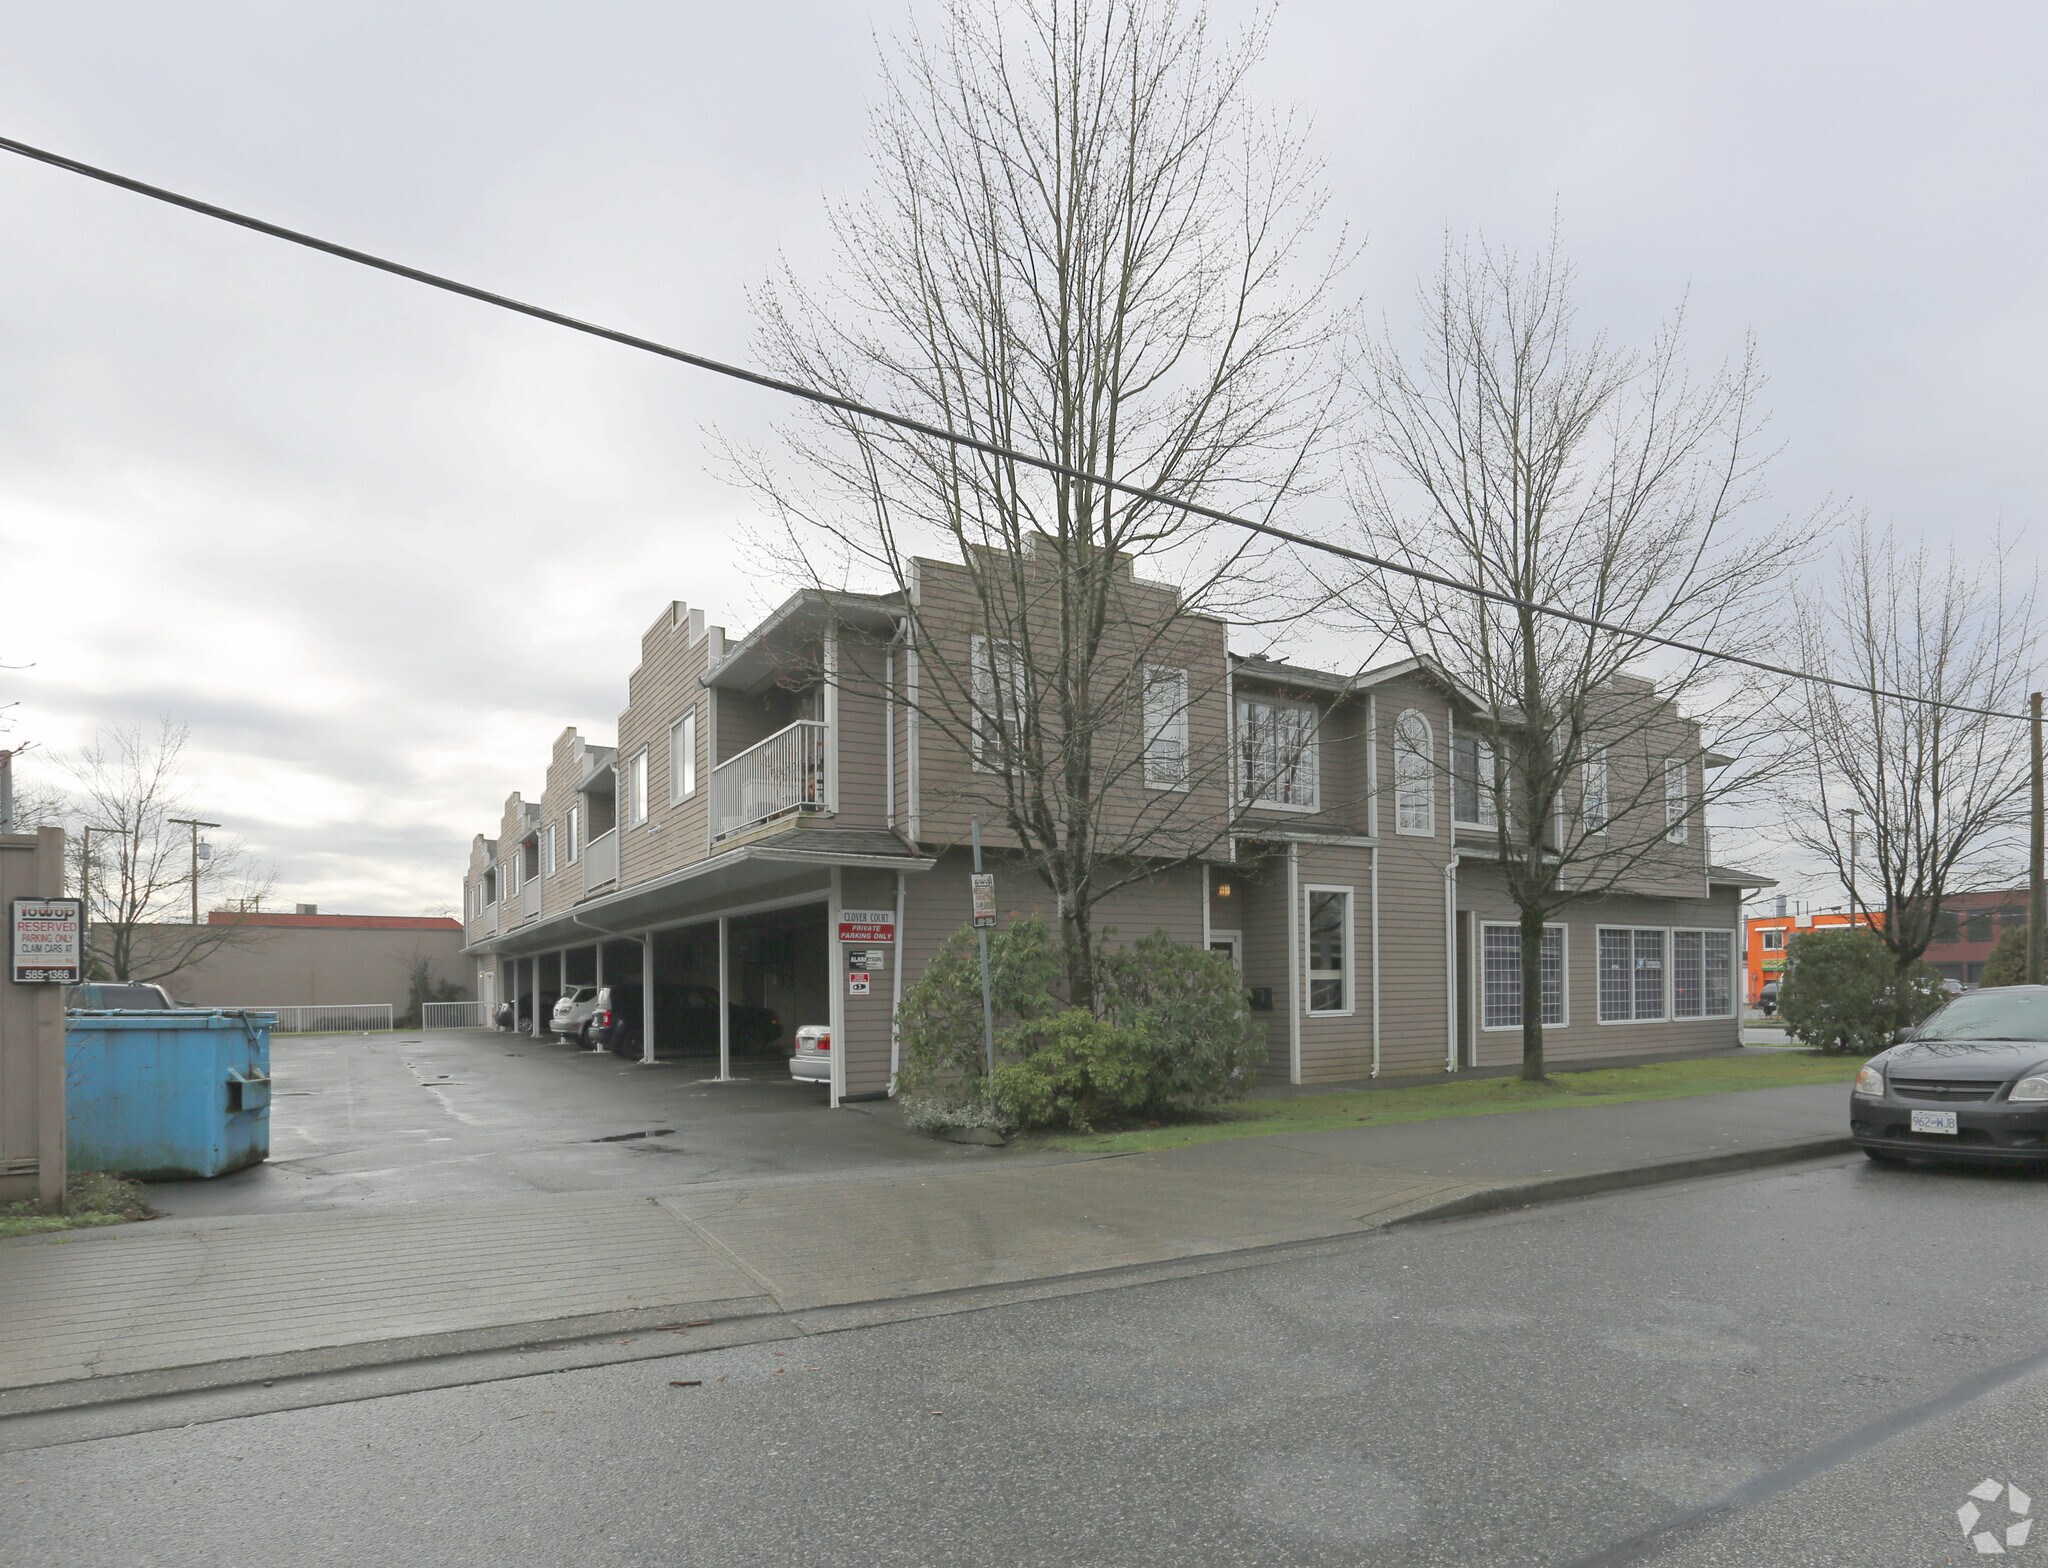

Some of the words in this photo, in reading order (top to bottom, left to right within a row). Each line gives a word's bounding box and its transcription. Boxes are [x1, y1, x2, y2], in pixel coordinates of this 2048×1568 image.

[844, 912, 868, 922] CLOVER
[870, 913, 889, 923] COURT
[17, 922, 77, 932] RESERVED
[21, 933, 52, 943] PARKING
[55, 934, 74, 943] ONLY
[840, 932, 871, 940] PARKING
[873, 932, 892, 940] ONLY
[21, 944, 42, 953] CLAIM
[44, 944, 63, 953] CARS
[65, 944, 73, 953] AT
[25, 969, 70, 979] 585-1366
